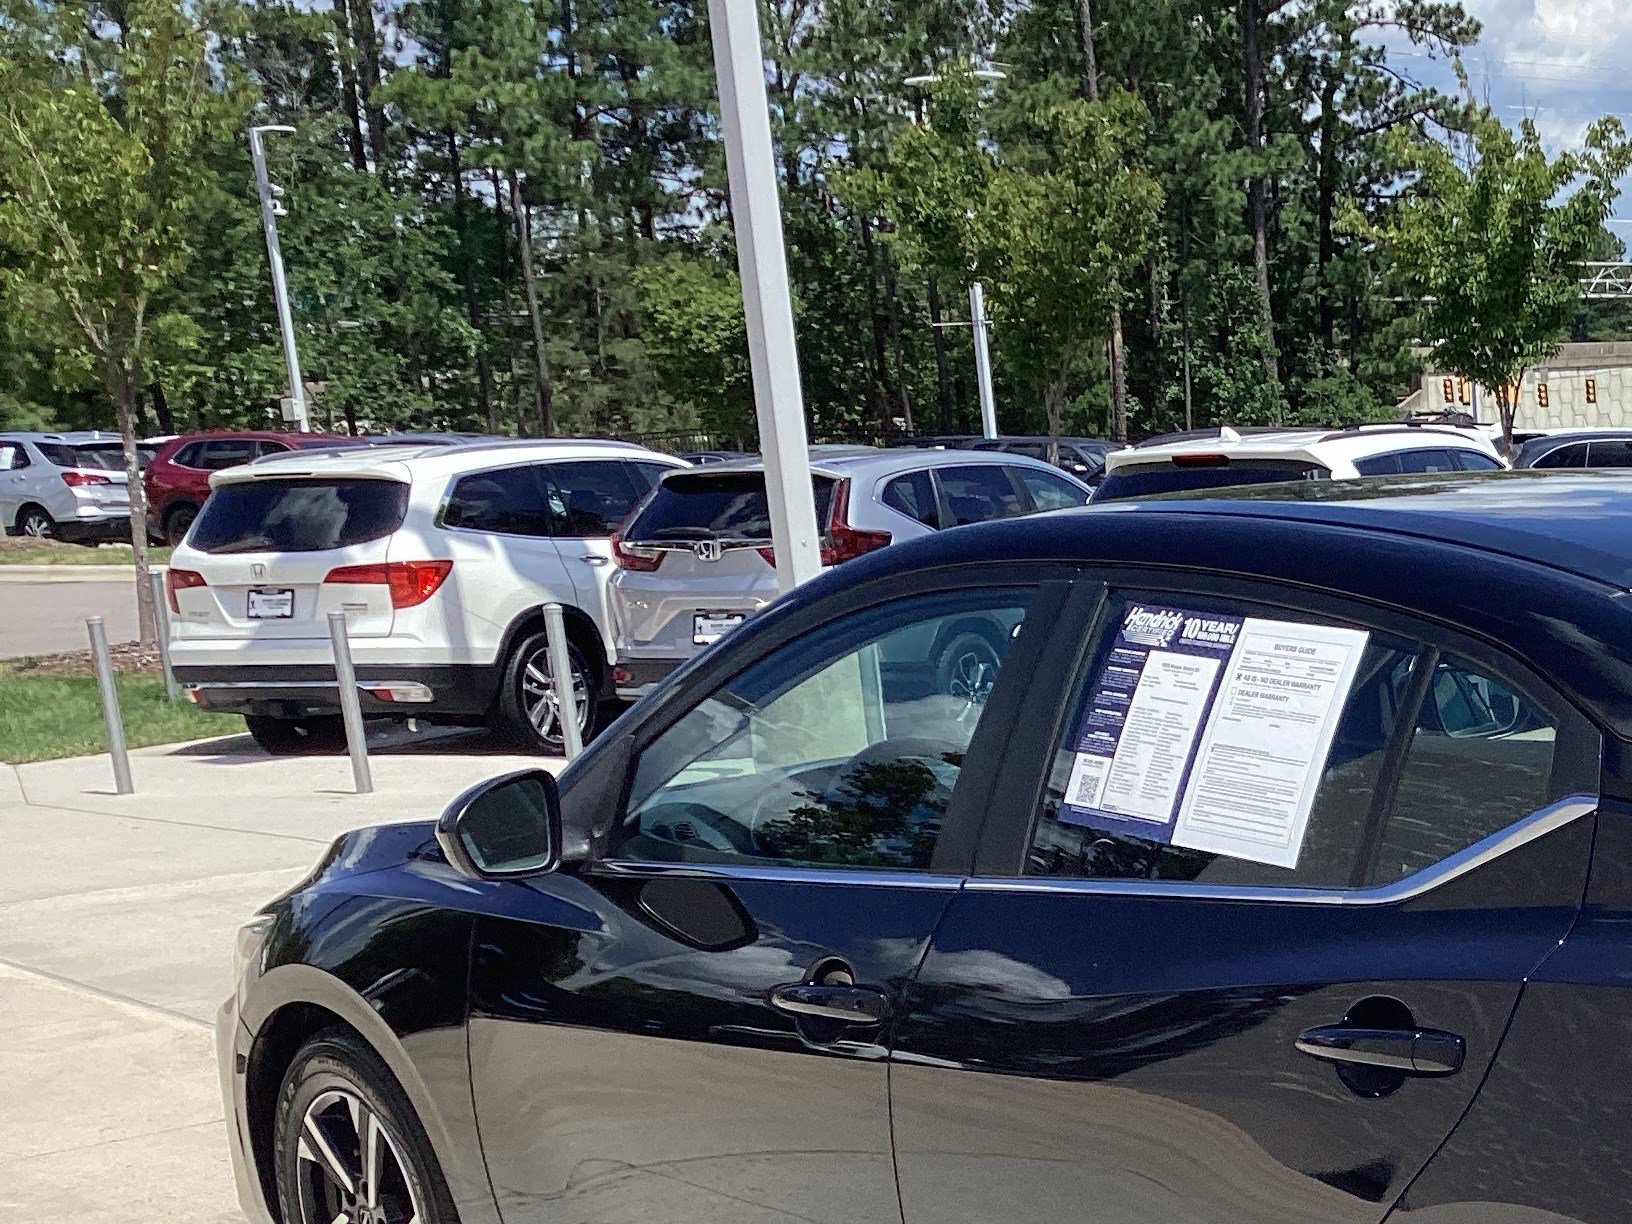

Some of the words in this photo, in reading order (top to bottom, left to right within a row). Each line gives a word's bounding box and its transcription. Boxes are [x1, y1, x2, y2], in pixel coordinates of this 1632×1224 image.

[1124, 606, 1183, 632] Hendrick
[1182, 617, 1202, 639] 10
[1274, 643, 1297, 652] BUYERS
[1297, 646, 1316, 655] GUIDE
[1269, 678, 1290, 687] DEALER
[1291, 680, 1321, 691] WARRANTY
[1238, 689, 1259, 698] DEALER
[1260, 691, 1289, 703] WARRANTY
